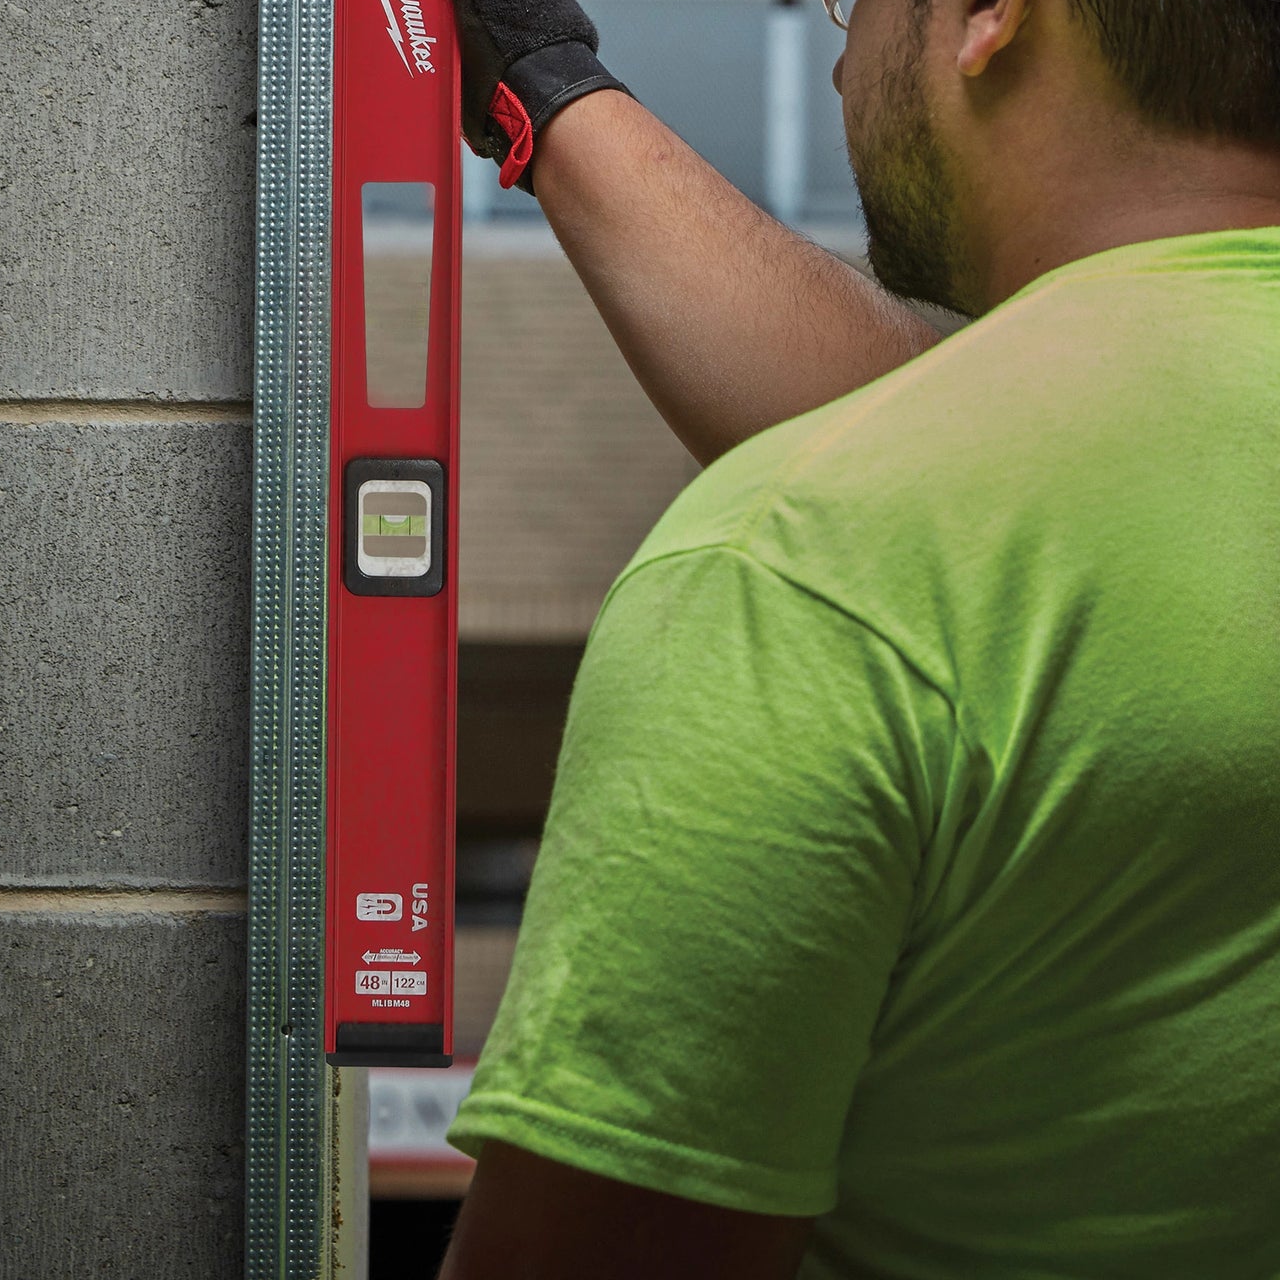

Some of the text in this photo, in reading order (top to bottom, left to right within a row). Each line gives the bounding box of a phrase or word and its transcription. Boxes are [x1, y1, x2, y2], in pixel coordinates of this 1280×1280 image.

[412, 883, 428, 931] USA
[360, 975, 380, 990] 48
[394, 977, 415, 989] 122
